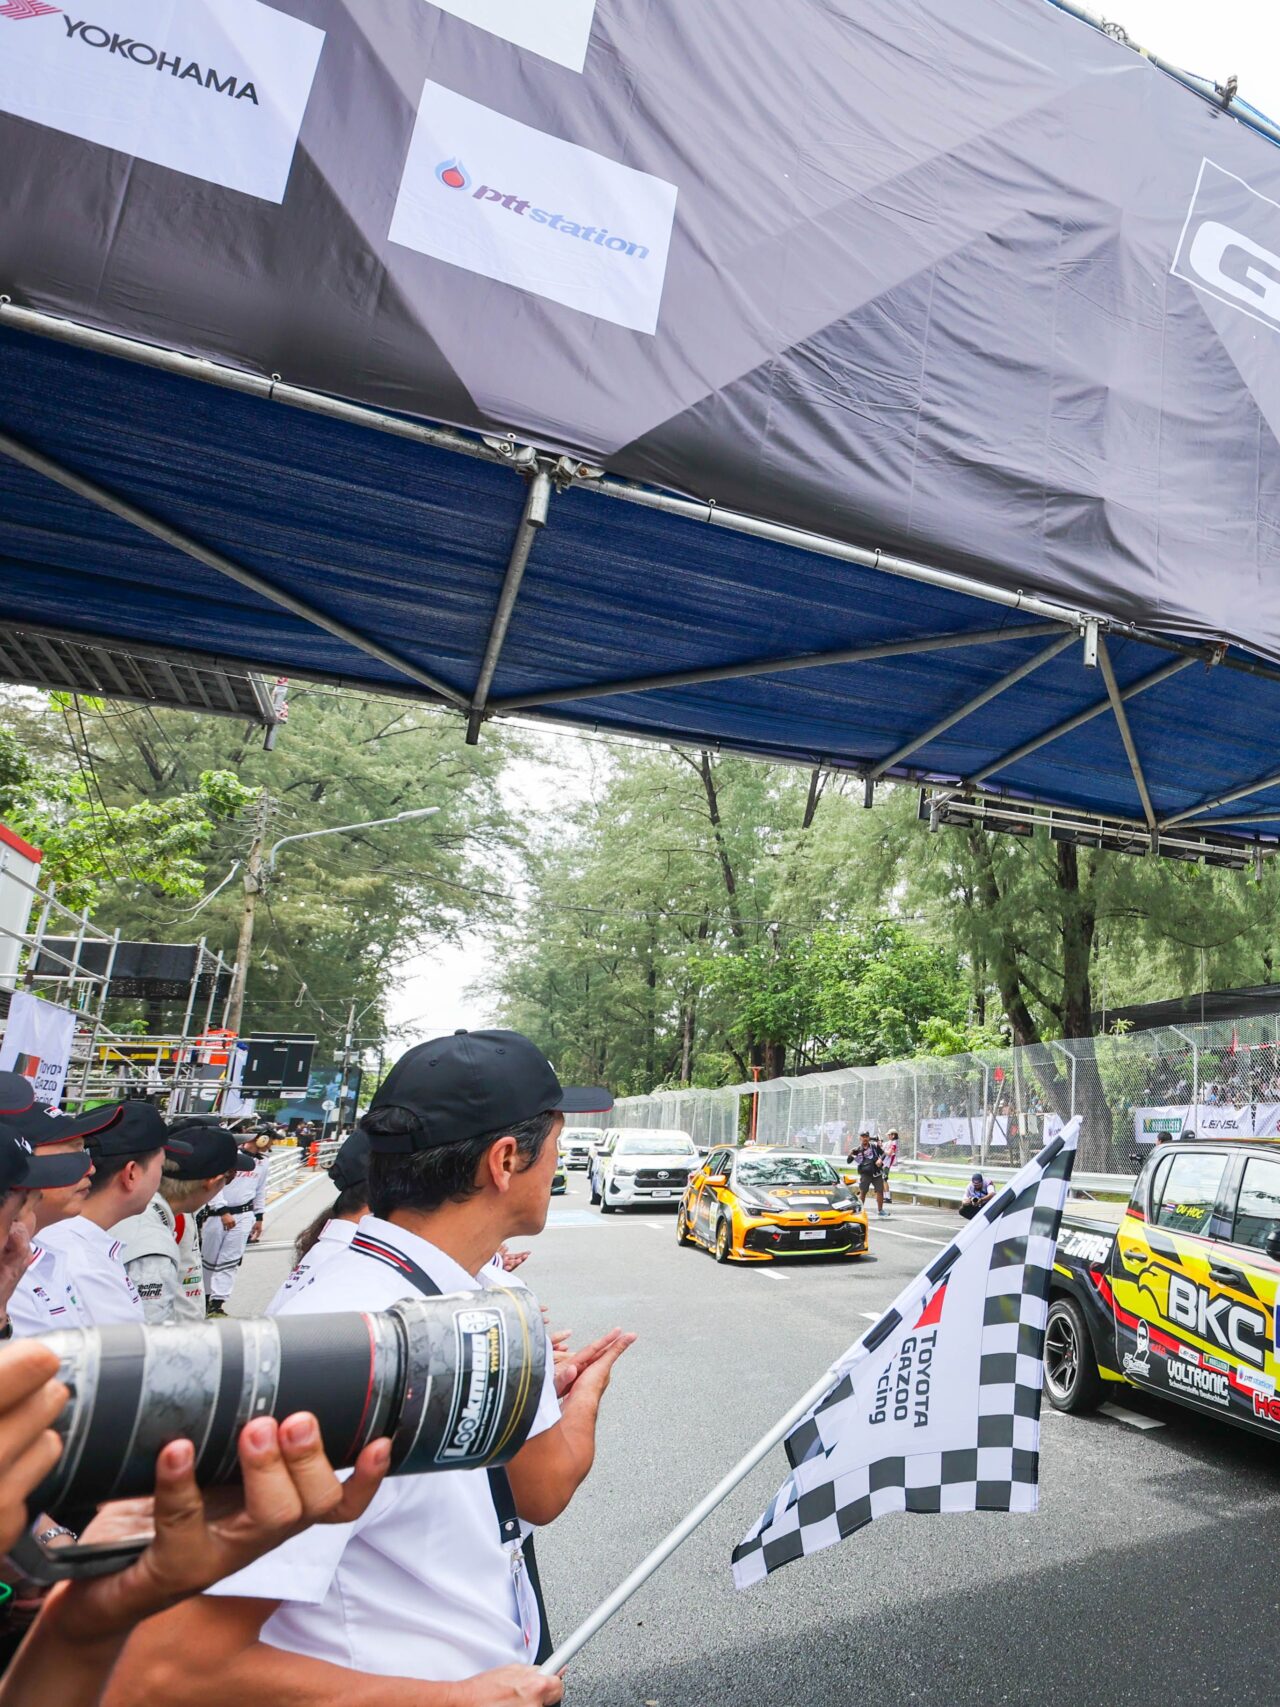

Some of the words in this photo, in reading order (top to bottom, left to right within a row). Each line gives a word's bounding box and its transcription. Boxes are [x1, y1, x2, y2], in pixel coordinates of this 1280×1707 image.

[61, 14, 260, 106] YOKOHAMA
[472, 183, 532, 218] ptt
[528, 202, 650, 261] station
[1168, 1275, 1267, 1367] BKC
[893, 1336, 918, 1421] GAZOO
[913, 1329, 938, 1428] TOYOTA
[1167, 1358, 1230, 1396] VOLTRONIC
